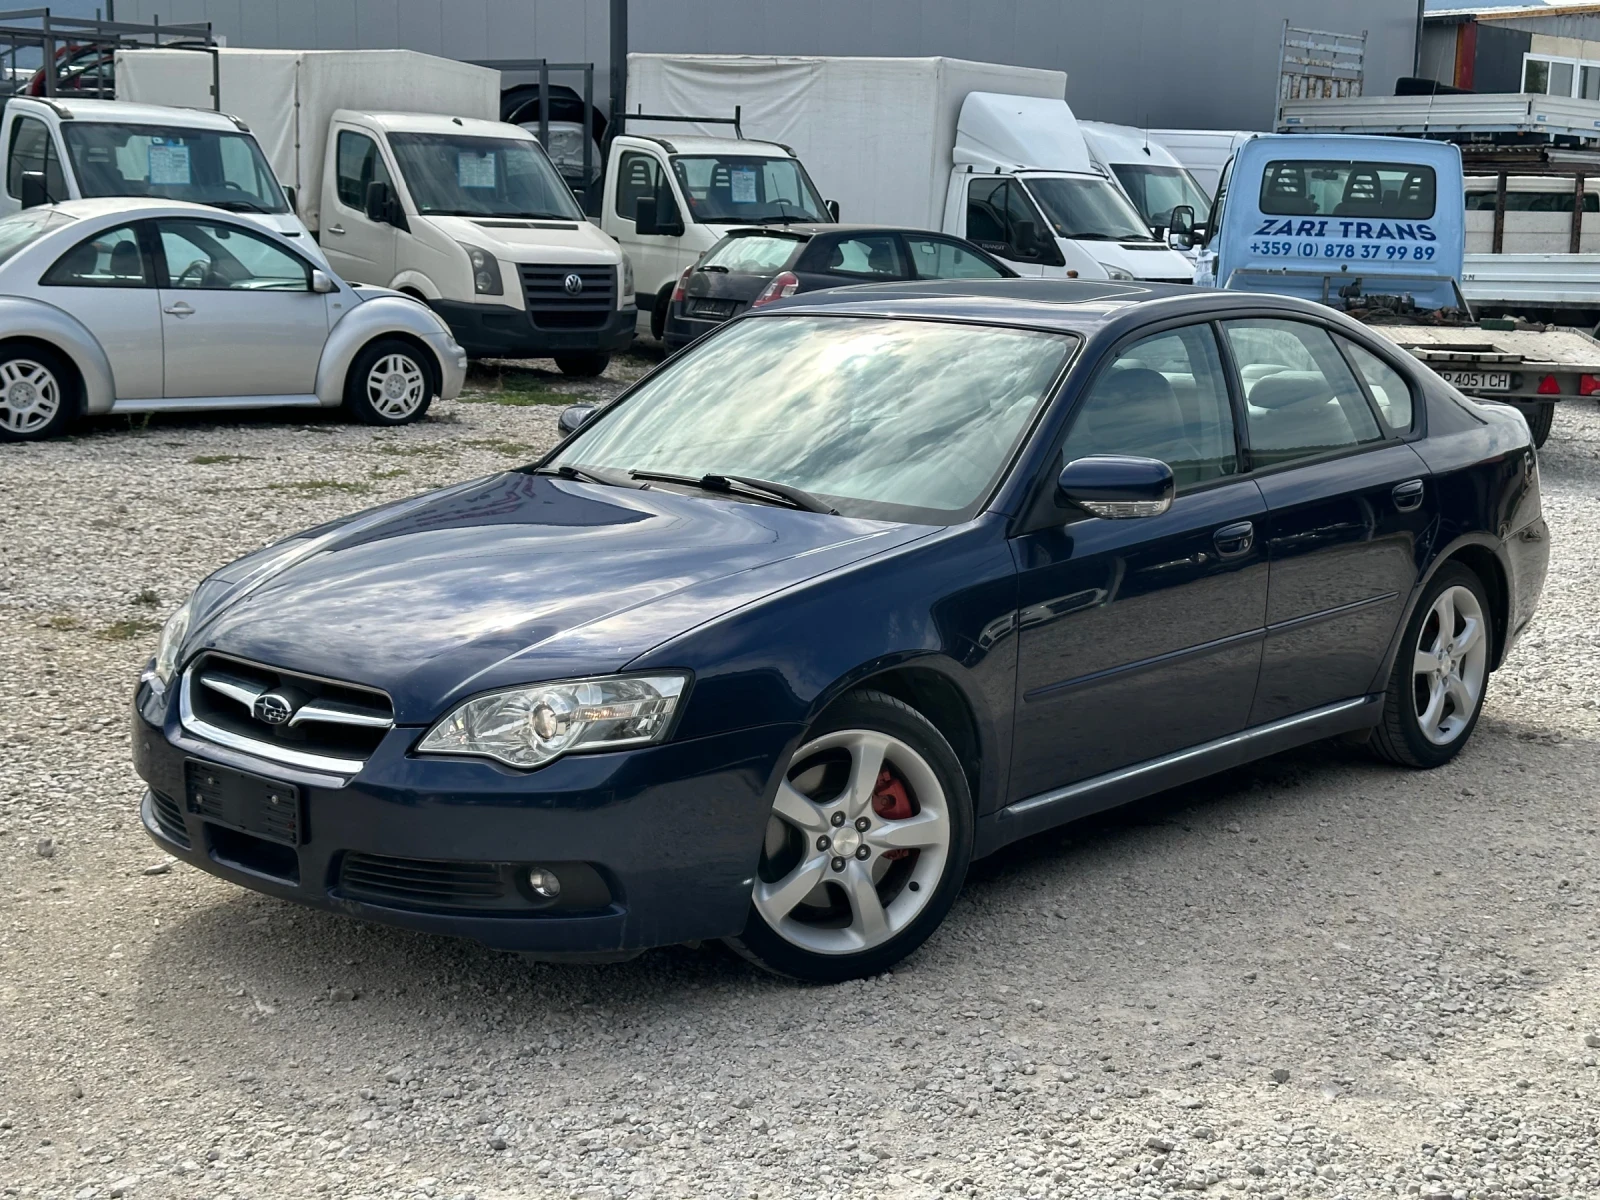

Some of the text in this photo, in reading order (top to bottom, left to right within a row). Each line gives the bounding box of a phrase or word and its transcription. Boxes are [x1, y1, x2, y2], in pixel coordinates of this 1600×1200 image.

[1253, 219, 1437, 241] ZARI TRANS
[1250, 241, 1436, 260] +359 (0) 878 37 99 89
[1454, 373, 1485, 387] 4051
[1489, 374, 1507, 388] CH
